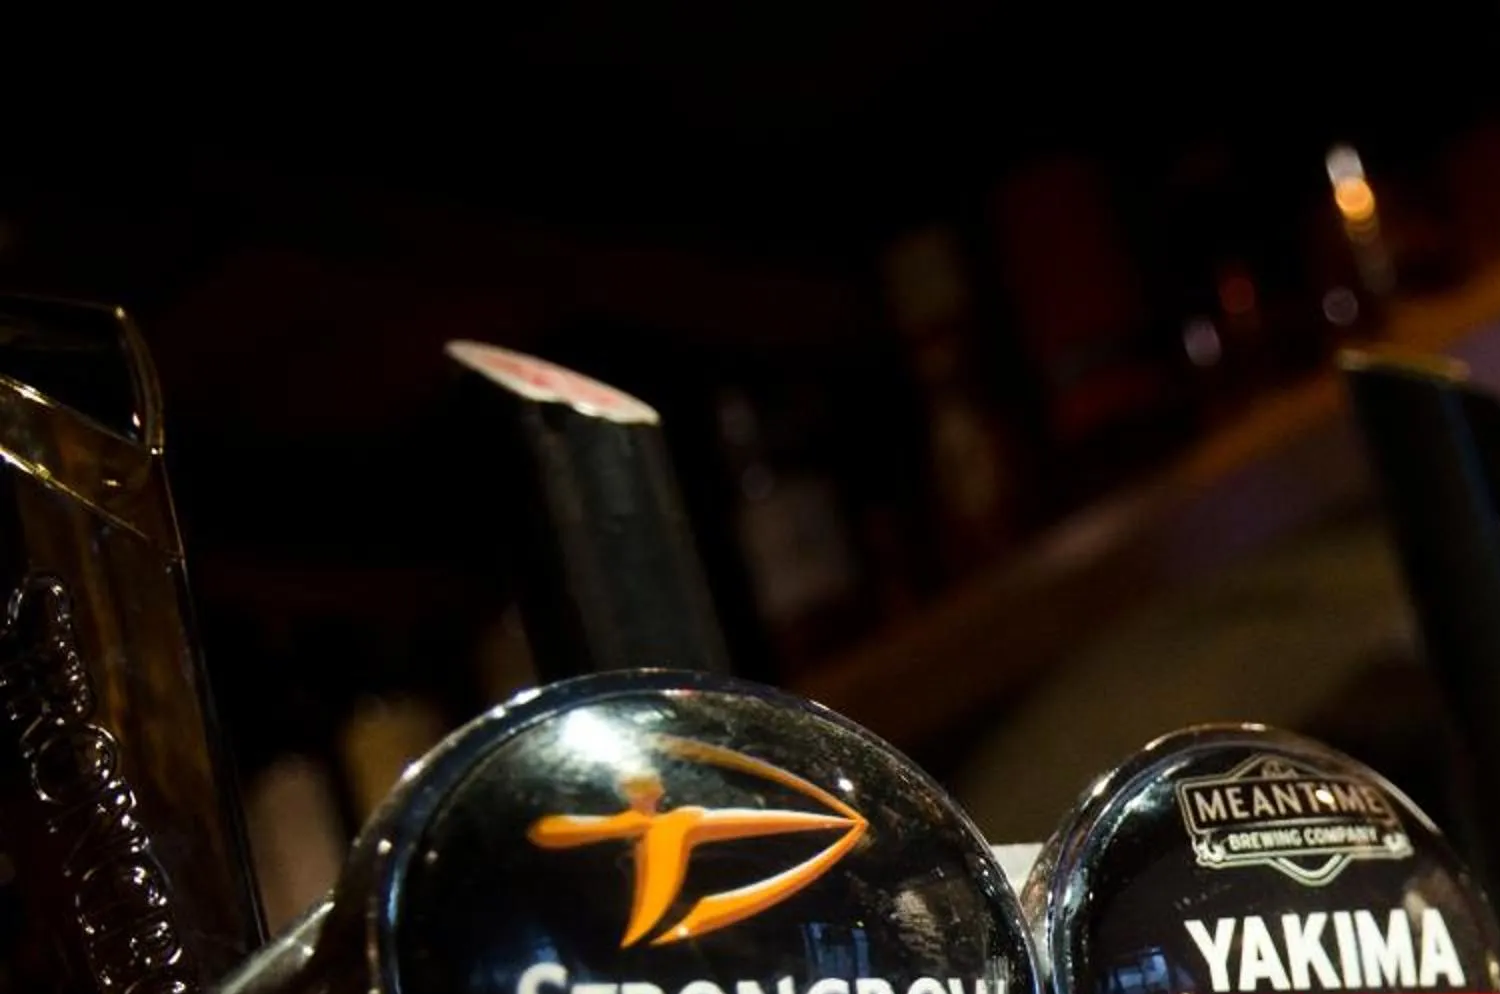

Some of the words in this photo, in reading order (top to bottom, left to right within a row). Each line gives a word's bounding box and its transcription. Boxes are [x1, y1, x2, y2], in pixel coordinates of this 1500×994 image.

[1193, 780, 1385, 823] MEANTIME
[1228, 830, 1302, 852] BREWING
[1303, 826, 1378, 846] COMPANY
[1185, 907, 1466, 993] YAKIMA
